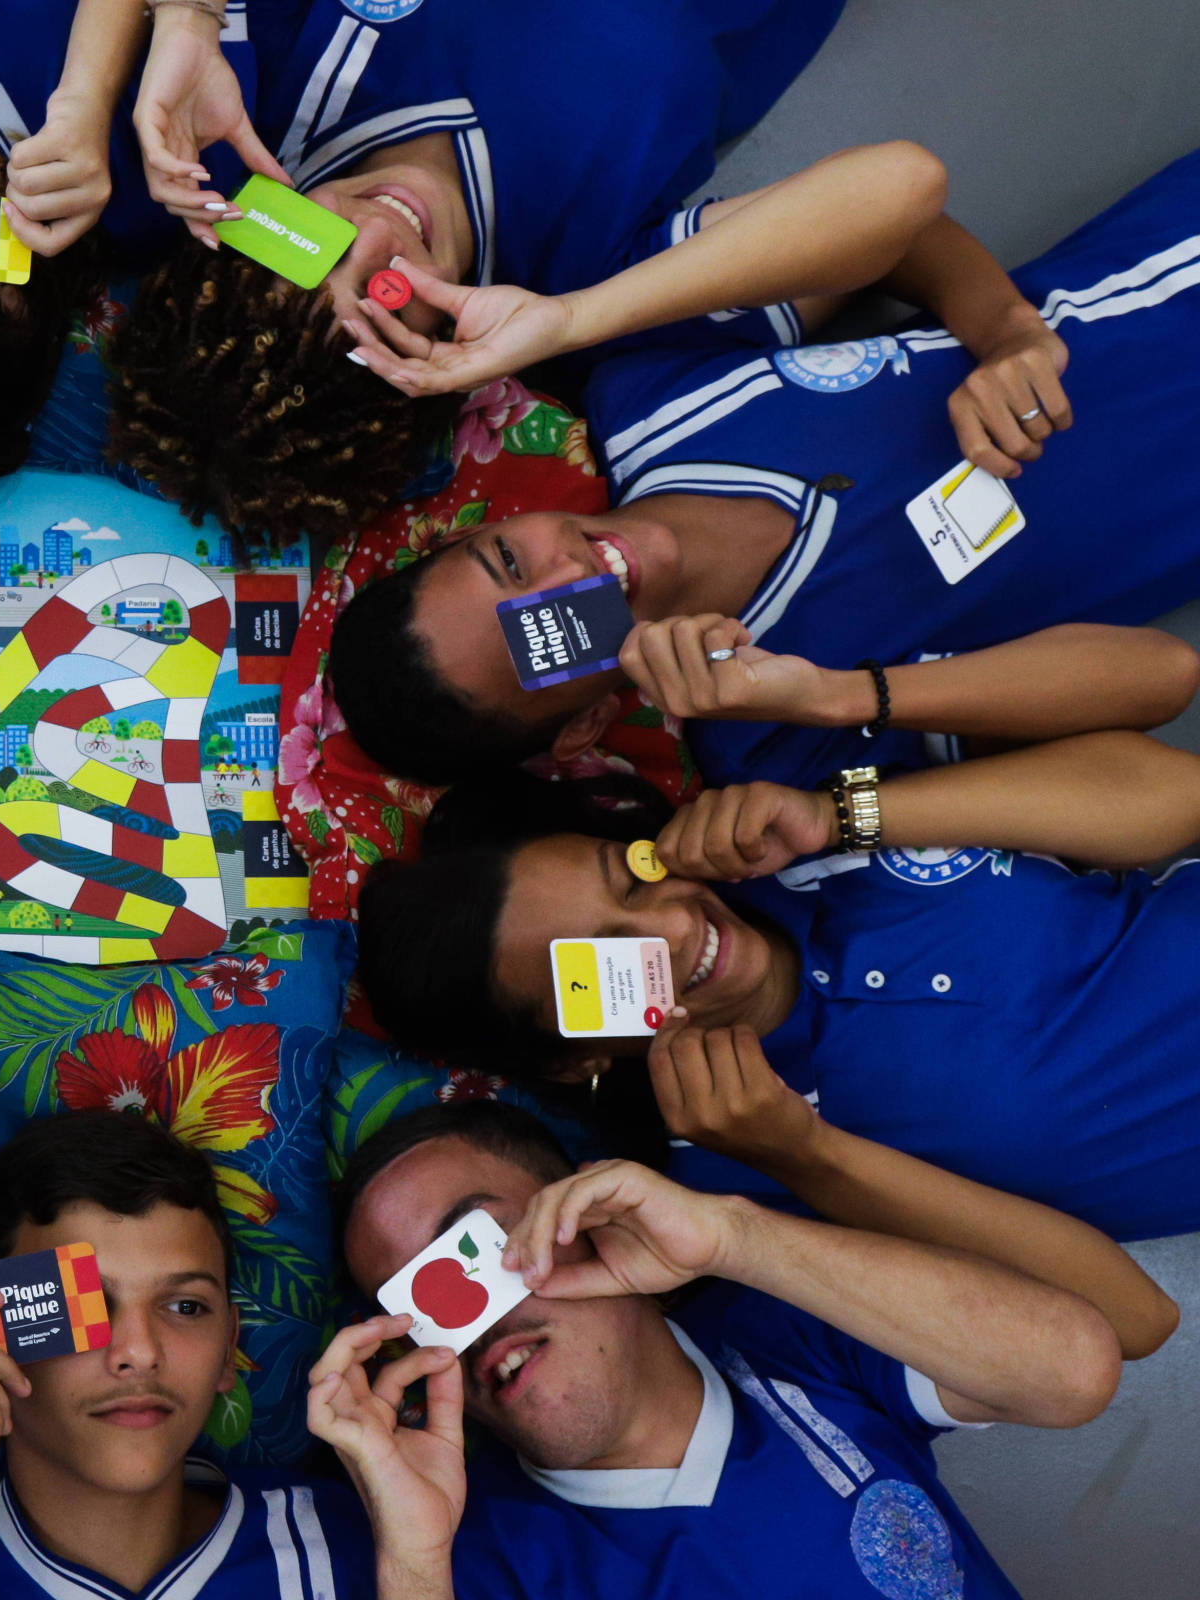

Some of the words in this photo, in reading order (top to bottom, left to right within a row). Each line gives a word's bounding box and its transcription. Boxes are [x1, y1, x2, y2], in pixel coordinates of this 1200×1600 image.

[246, 208, 320, 255] CARTA-CHEQUE
[929, 530, 946, 546] 5
[538, 607, 570, 665] nique
[272, 829, 280, 857] ganhos
[571, 981, 588, 992] ?
[5, 1300, 59, 1323] nique
